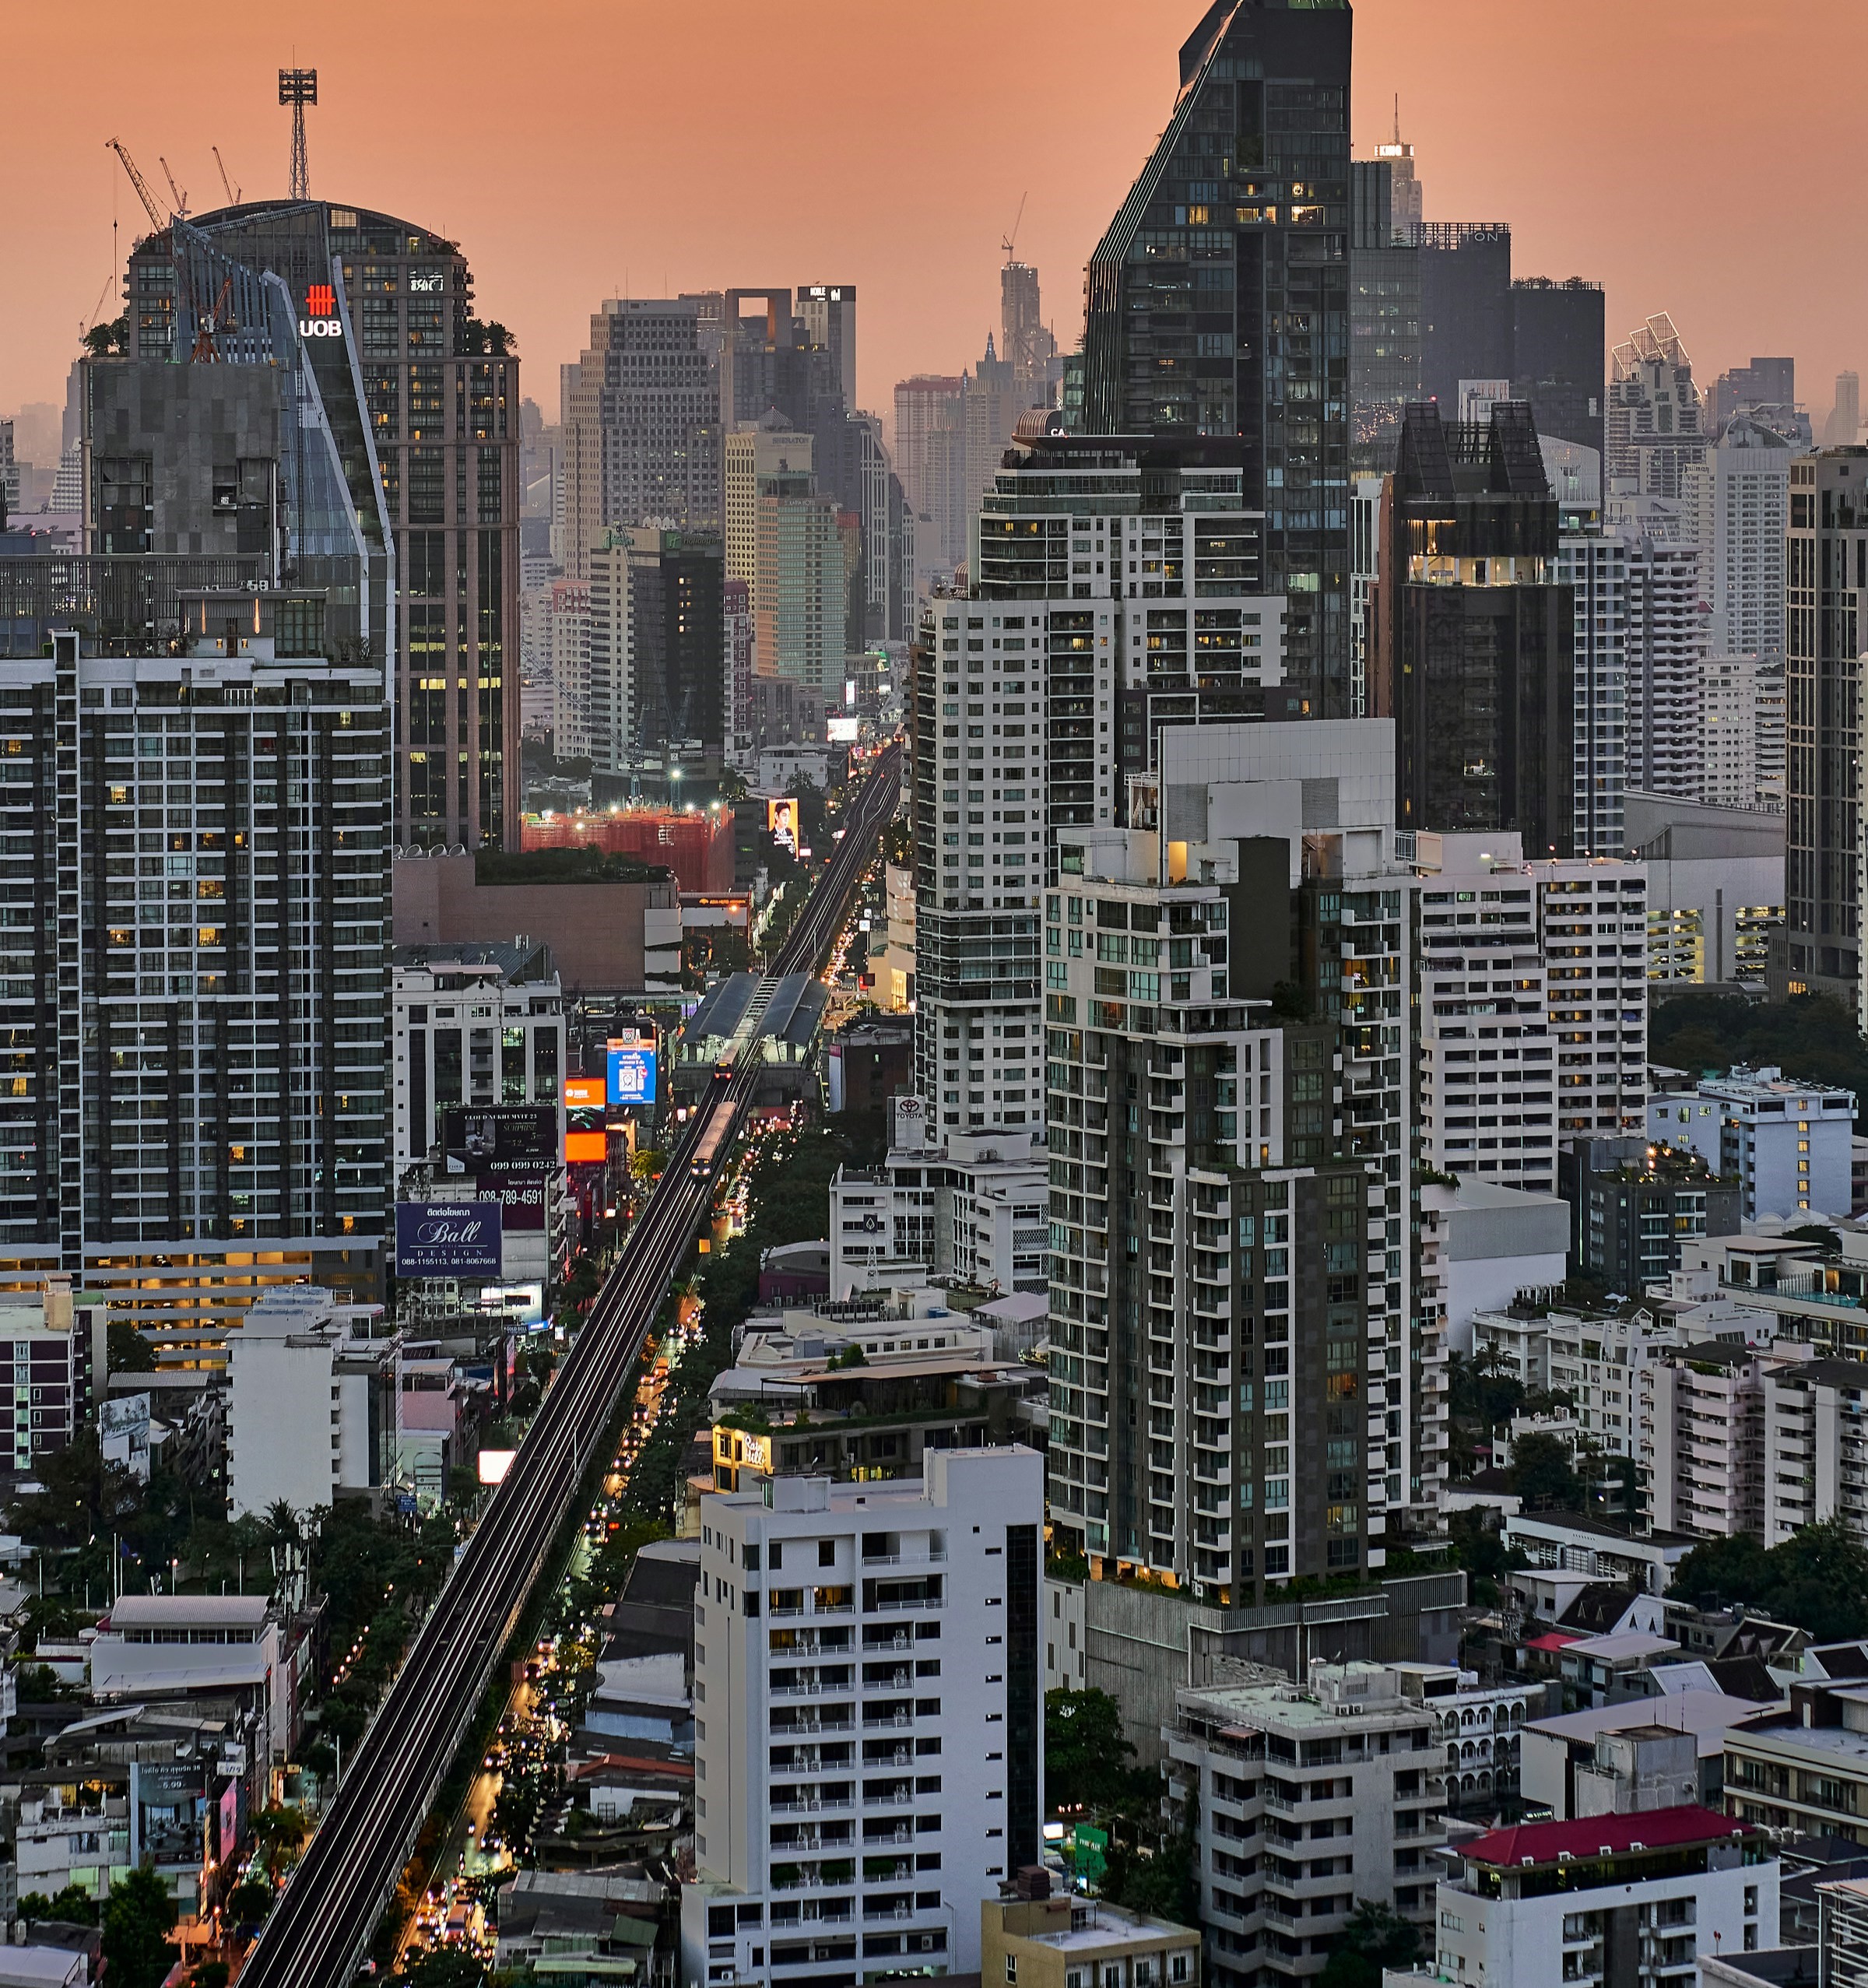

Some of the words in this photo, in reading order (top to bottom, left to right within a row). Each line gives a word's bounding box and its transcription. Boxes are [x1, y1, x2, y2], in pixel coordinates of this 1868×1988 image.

[1423, 232, 1498, 242] ASHTON
[300, 320, 342, 337] UOB
[532, 1161, 555, 1169] 0242
[479, 1189, 542, 1206] 098-789-4591
[417, 1221, 482, 1243] Ball
